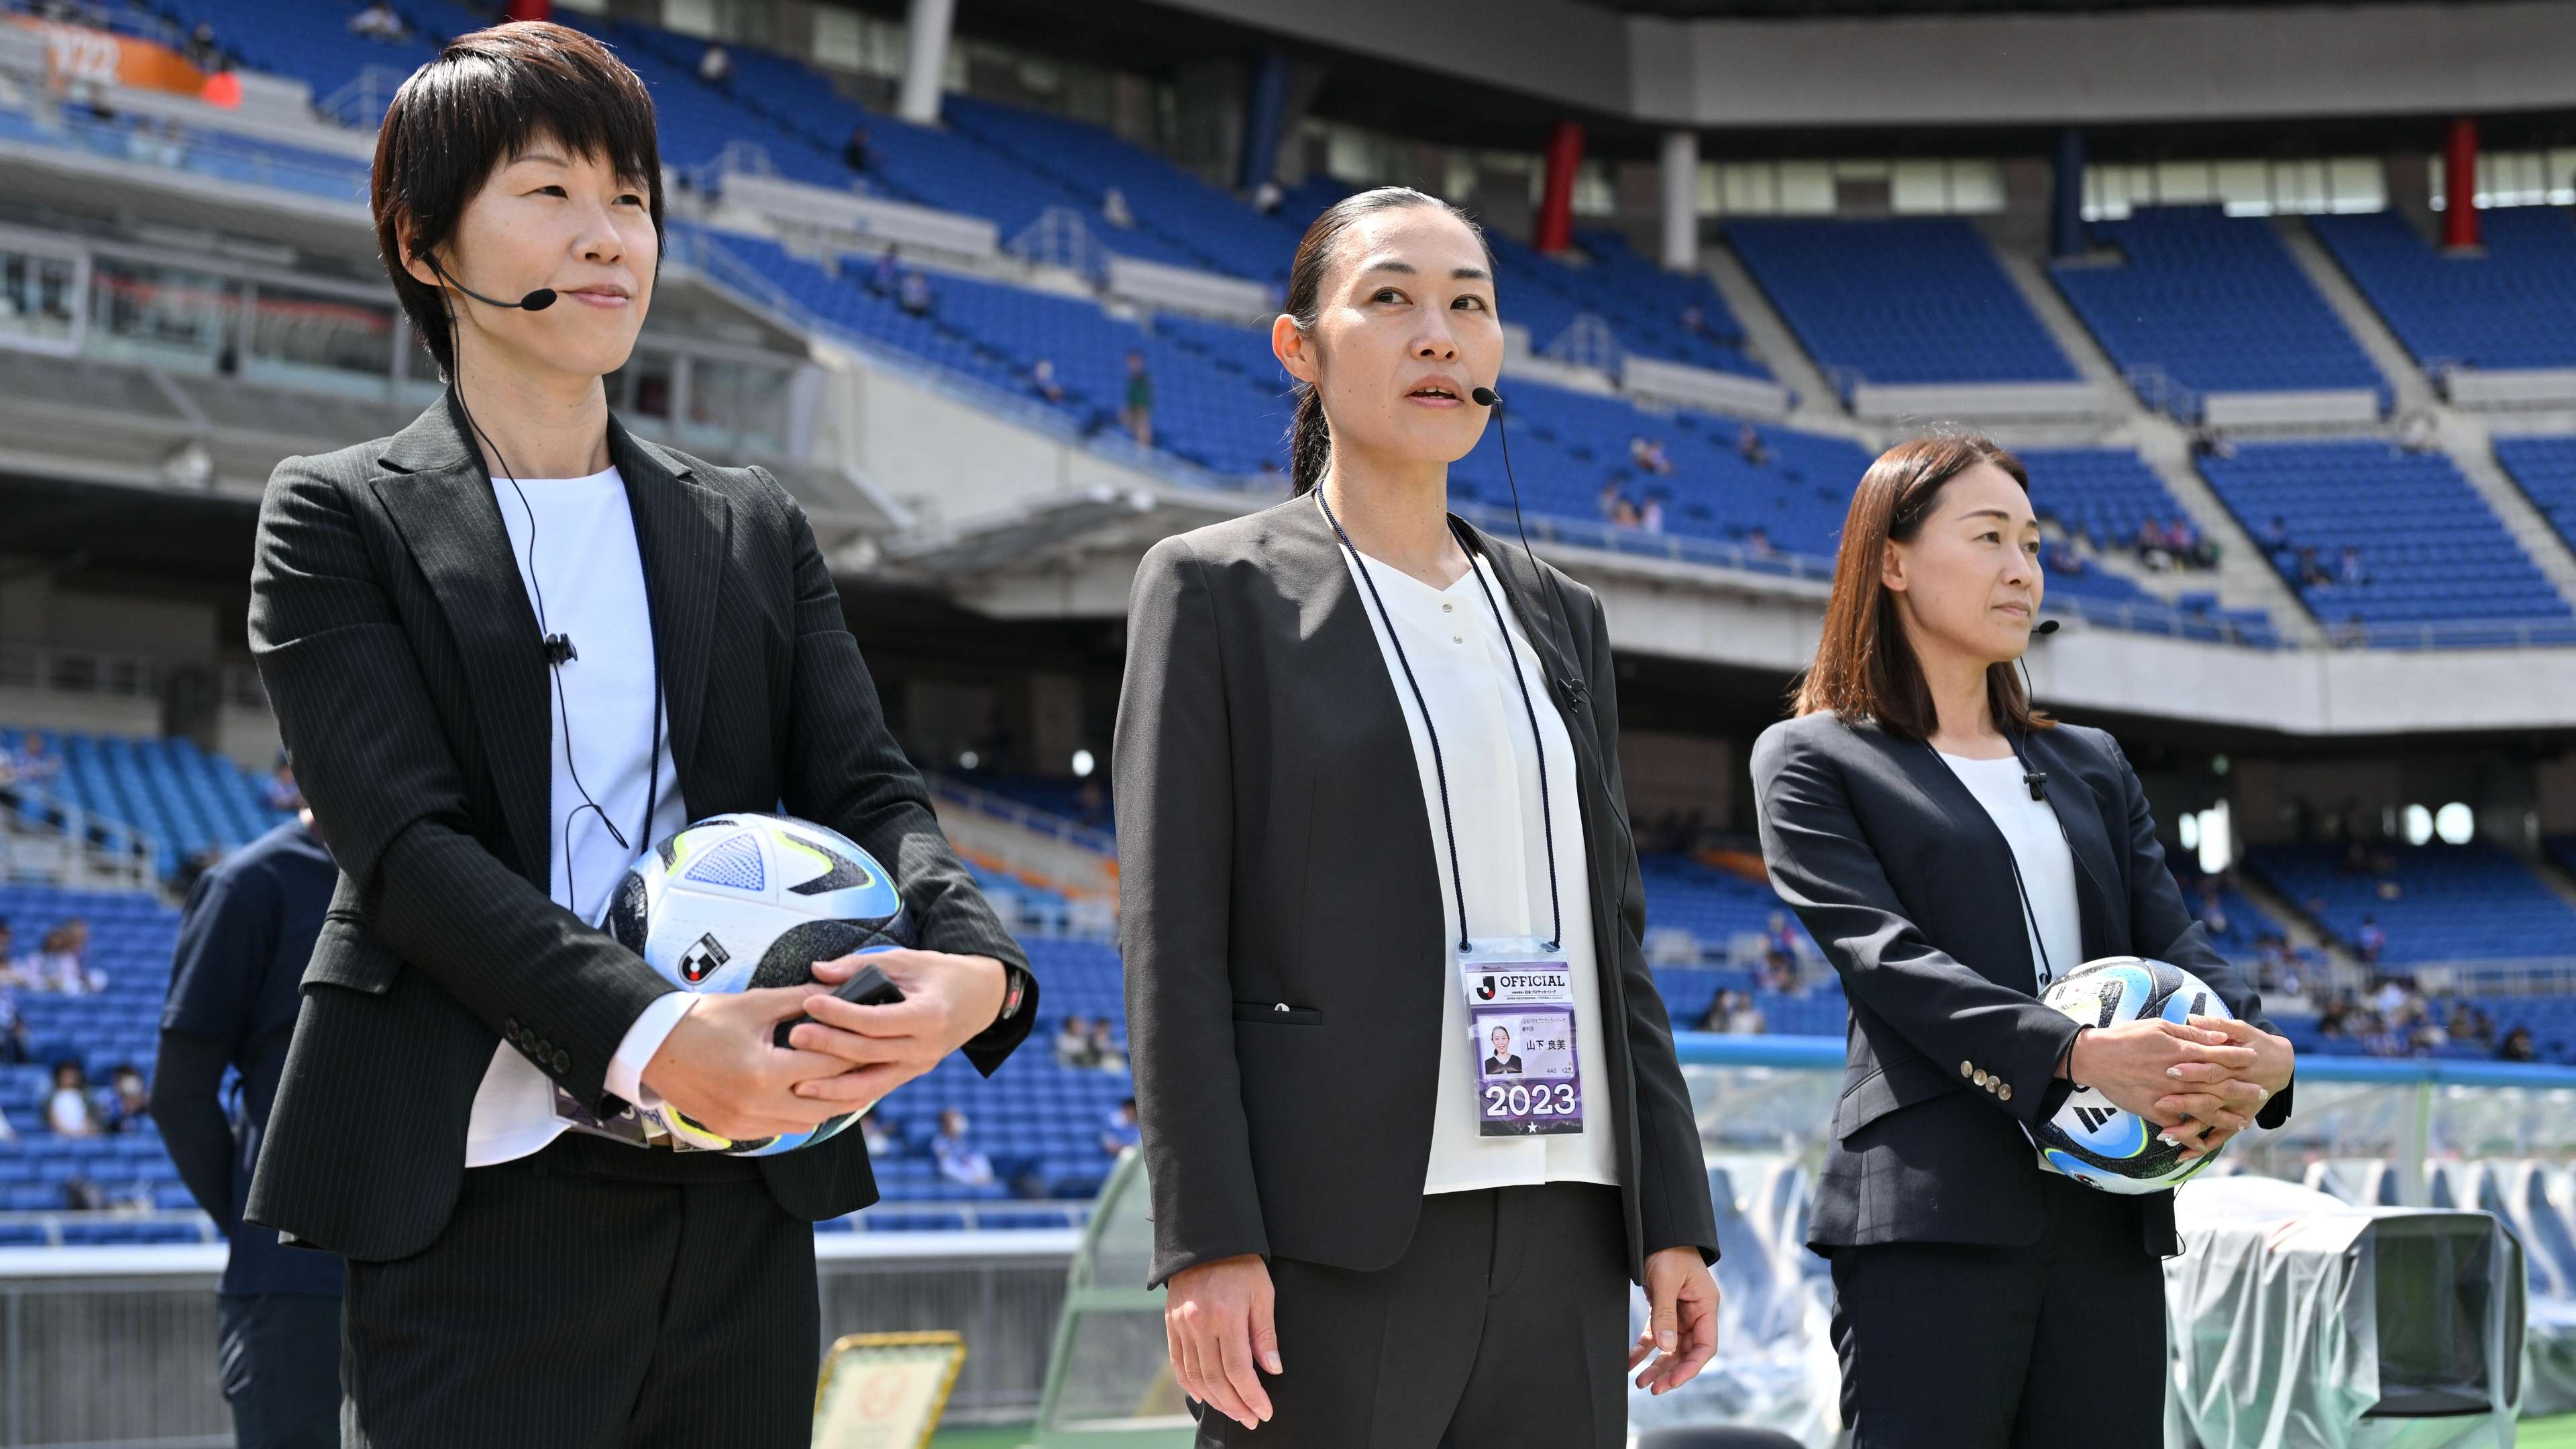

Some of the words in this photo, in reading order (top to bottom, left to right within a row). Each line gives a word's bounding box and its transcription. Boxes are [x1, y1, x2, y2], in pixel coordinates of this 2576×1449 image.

[1500, 975, 1565, 987] OFFICIAL
[1526, 1039, 1544, 1051] 山下
[1548, 1039, 1566, 1051] 良美
[1485, 1083, 1576, 1116] 2023
